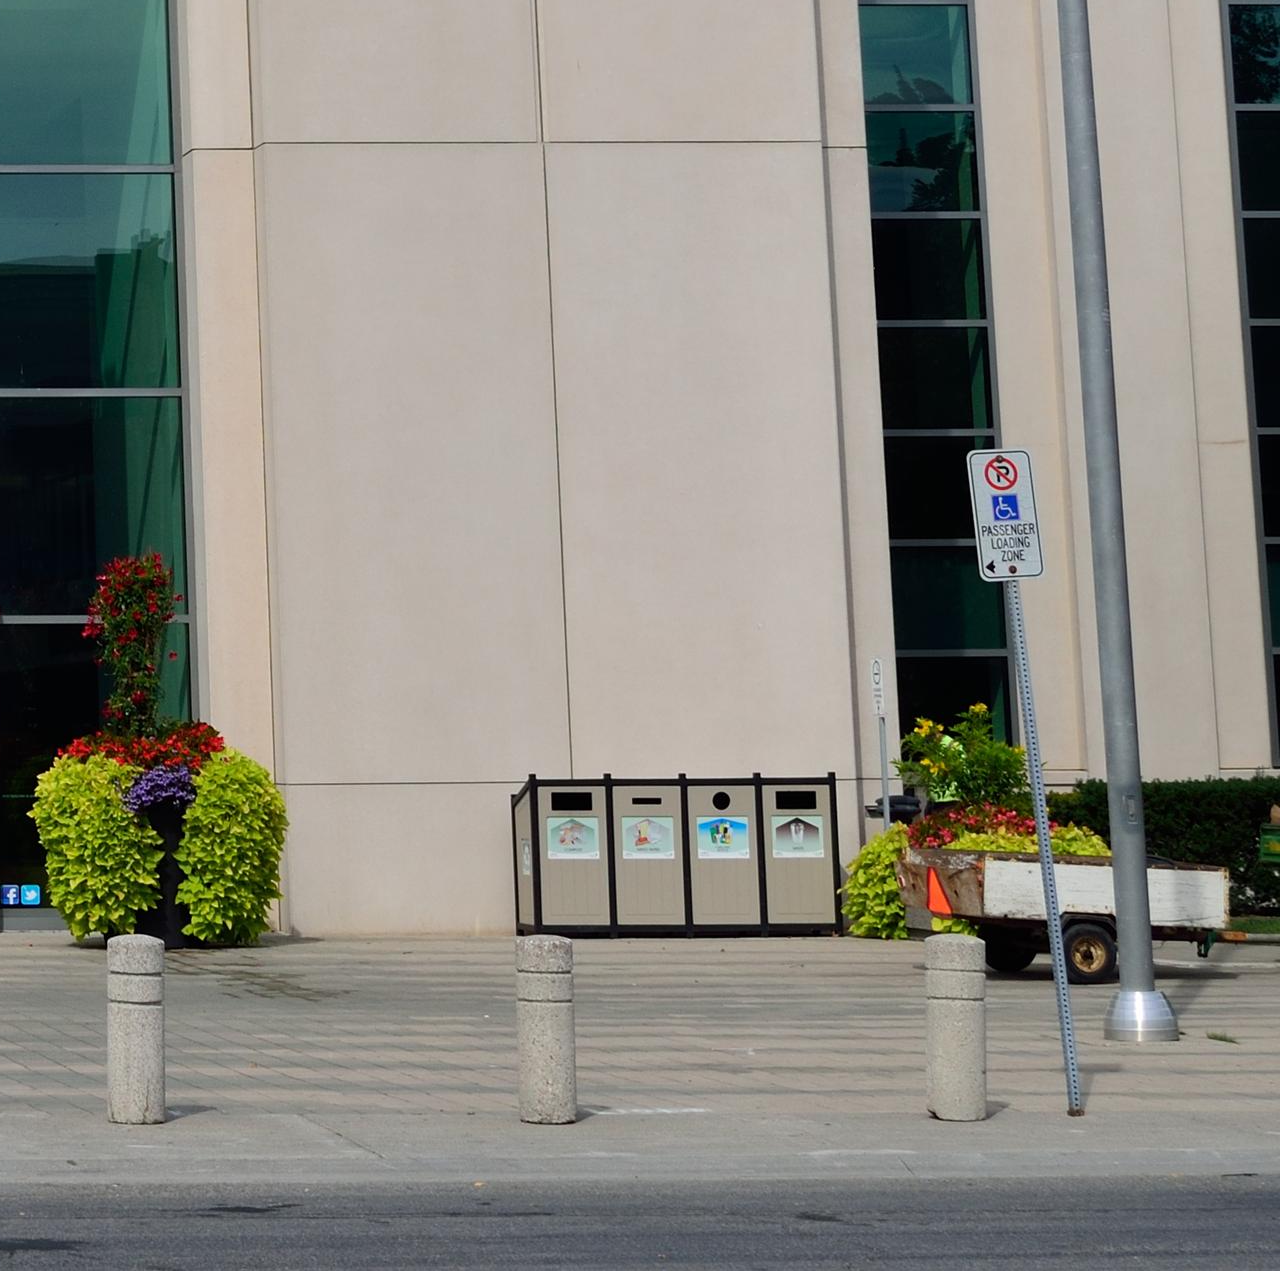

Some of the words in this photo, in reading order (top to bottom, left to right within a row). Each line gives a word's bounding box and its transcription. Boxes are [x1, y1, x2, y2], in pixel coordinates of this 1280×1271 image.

[981, 523, 1035, 537] PASSENGER
[991, 536, 1030, 550] LOADING
[1001, 549, 1026, 562] ZONE
